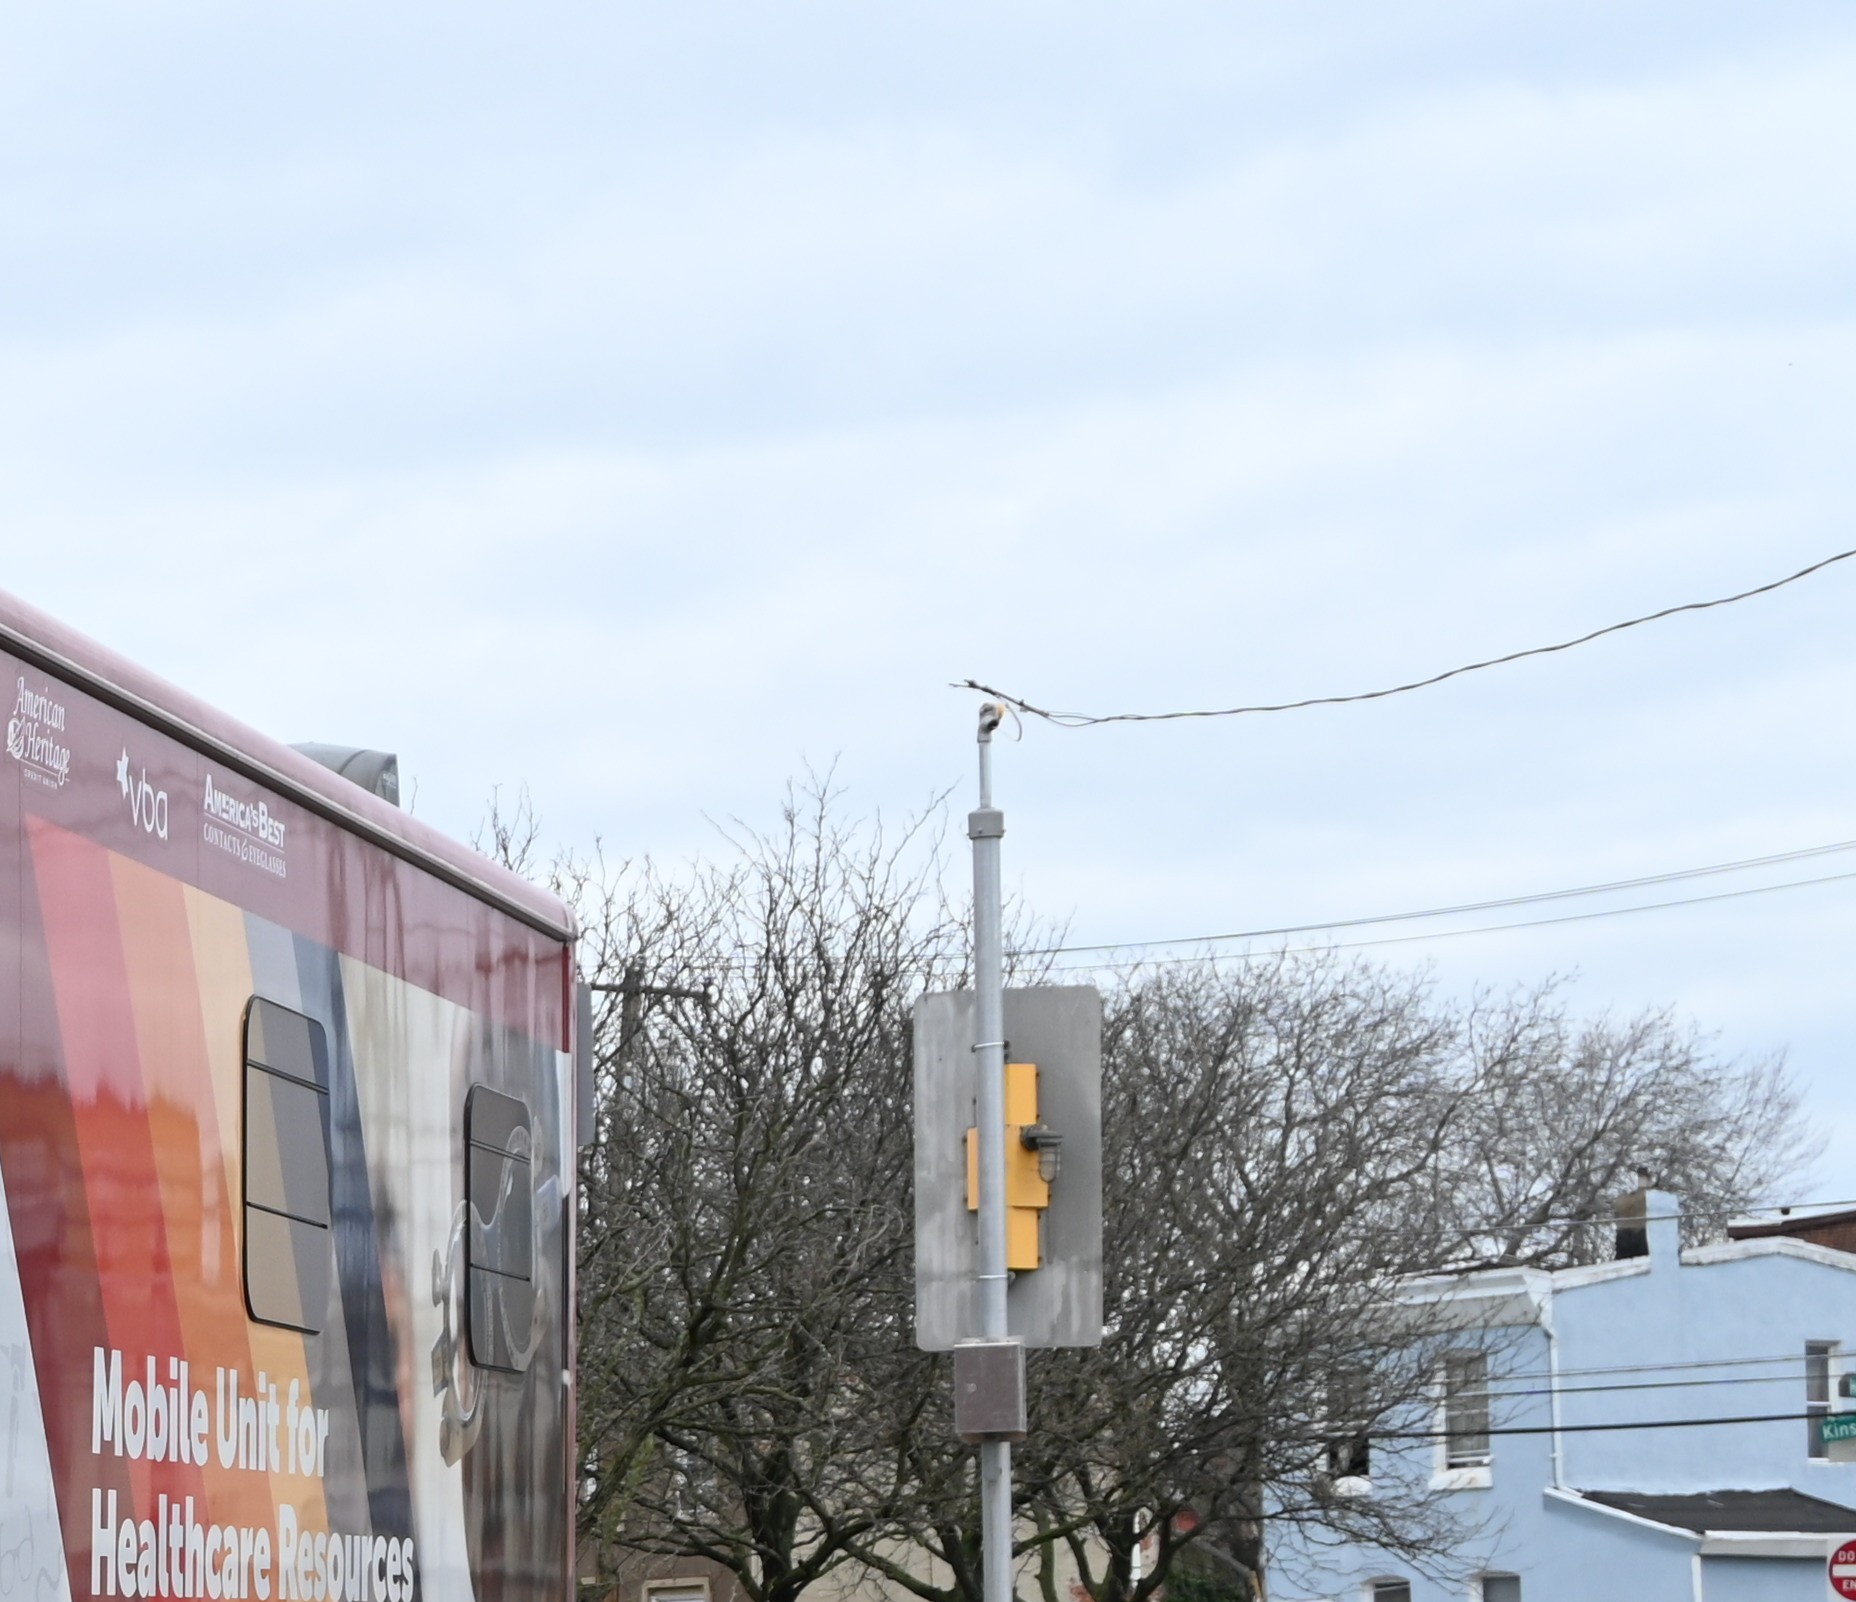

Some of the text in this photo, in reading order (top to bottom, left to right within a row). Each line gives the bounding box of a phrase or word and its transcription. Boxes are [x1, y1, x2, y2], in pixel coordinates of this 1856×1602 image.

[13, 676, 65, 732] American
[25, 721, 70, 786] Heritage
[128, 767, 168, 840] vba
[258, 800, 285, 848] BEST
[203, 822, 241, 857] CONTACTS
[248, 844, 287, 878] EYEGLASSES
[91, 1346, 329, 1478] Mobile Unit for
[91, 1488, 271, 1600] Healthcare
[1838, 1550, 1855, 1562] DO
